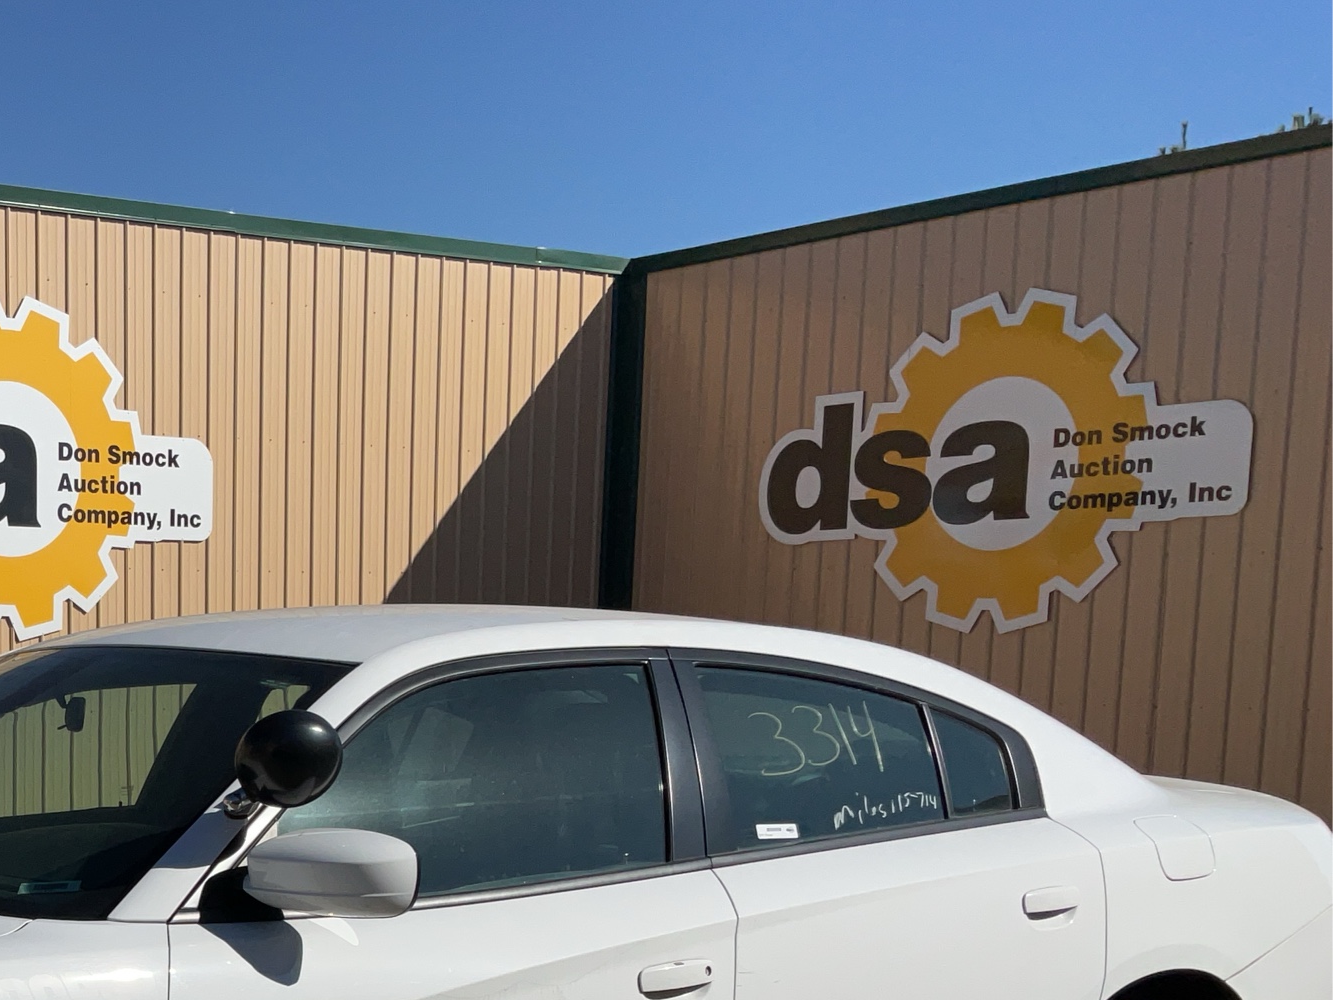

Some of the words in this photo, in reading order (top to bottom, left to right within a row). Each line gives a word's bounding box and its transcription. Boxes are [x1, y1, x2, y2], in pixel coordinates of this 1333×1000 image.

[1053, 427, 1103, 448] Don
[1112, 415, 1206, 443] Smock
[58, 441, 100, 463] Don
[107, 444, 180, 468] Smock
[766, 402, 1030, 535] dsa
[1050, 454, 1153, 480] Auction
[57, 473, 142, 496] Auction
[1048, 488, 1178, 513] Company,
[1188, 481, 1233, 503] Inc
[57, 503, 162, 530] Company,
[170, 508, 202, 528] Inc
[747, 700, 885, 777] 3314
